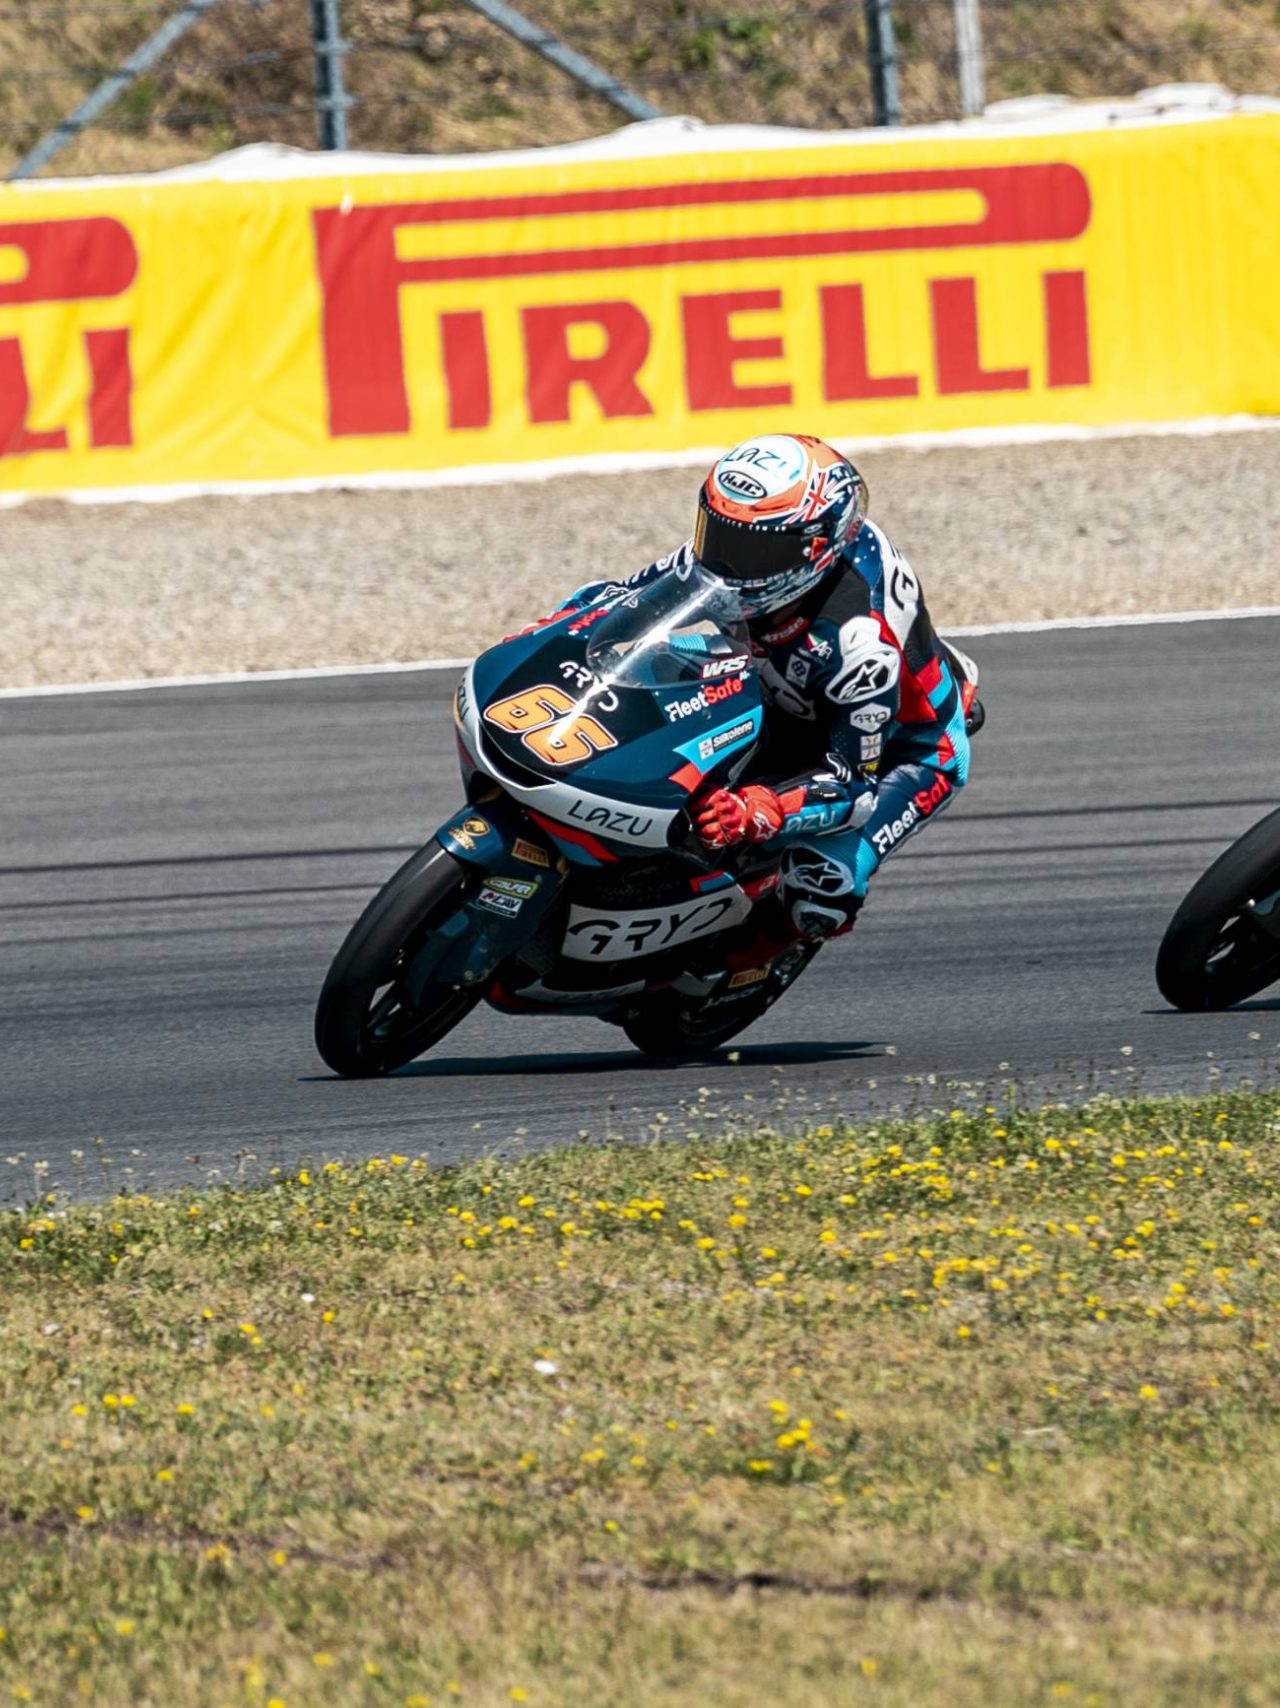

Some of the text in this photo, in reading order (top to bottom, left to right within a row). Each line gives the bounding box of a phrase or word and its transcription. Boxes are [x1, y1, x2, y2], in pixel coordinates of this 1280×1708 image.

[311, 161, 1091, 436] PIRELLI
[722, 473, 761, 496] HJC
[702, 655, 748, 679] WRS
[664, 679, 744, 723] FleetSafe
[483, 684, 619, 765] 66
[568, 800, 653, 837] LAZU
[783, 810, 837, 834] AZU
[871, 769, 952, 855] FleetSaf
[568, 897, 733, 955] GRYD
